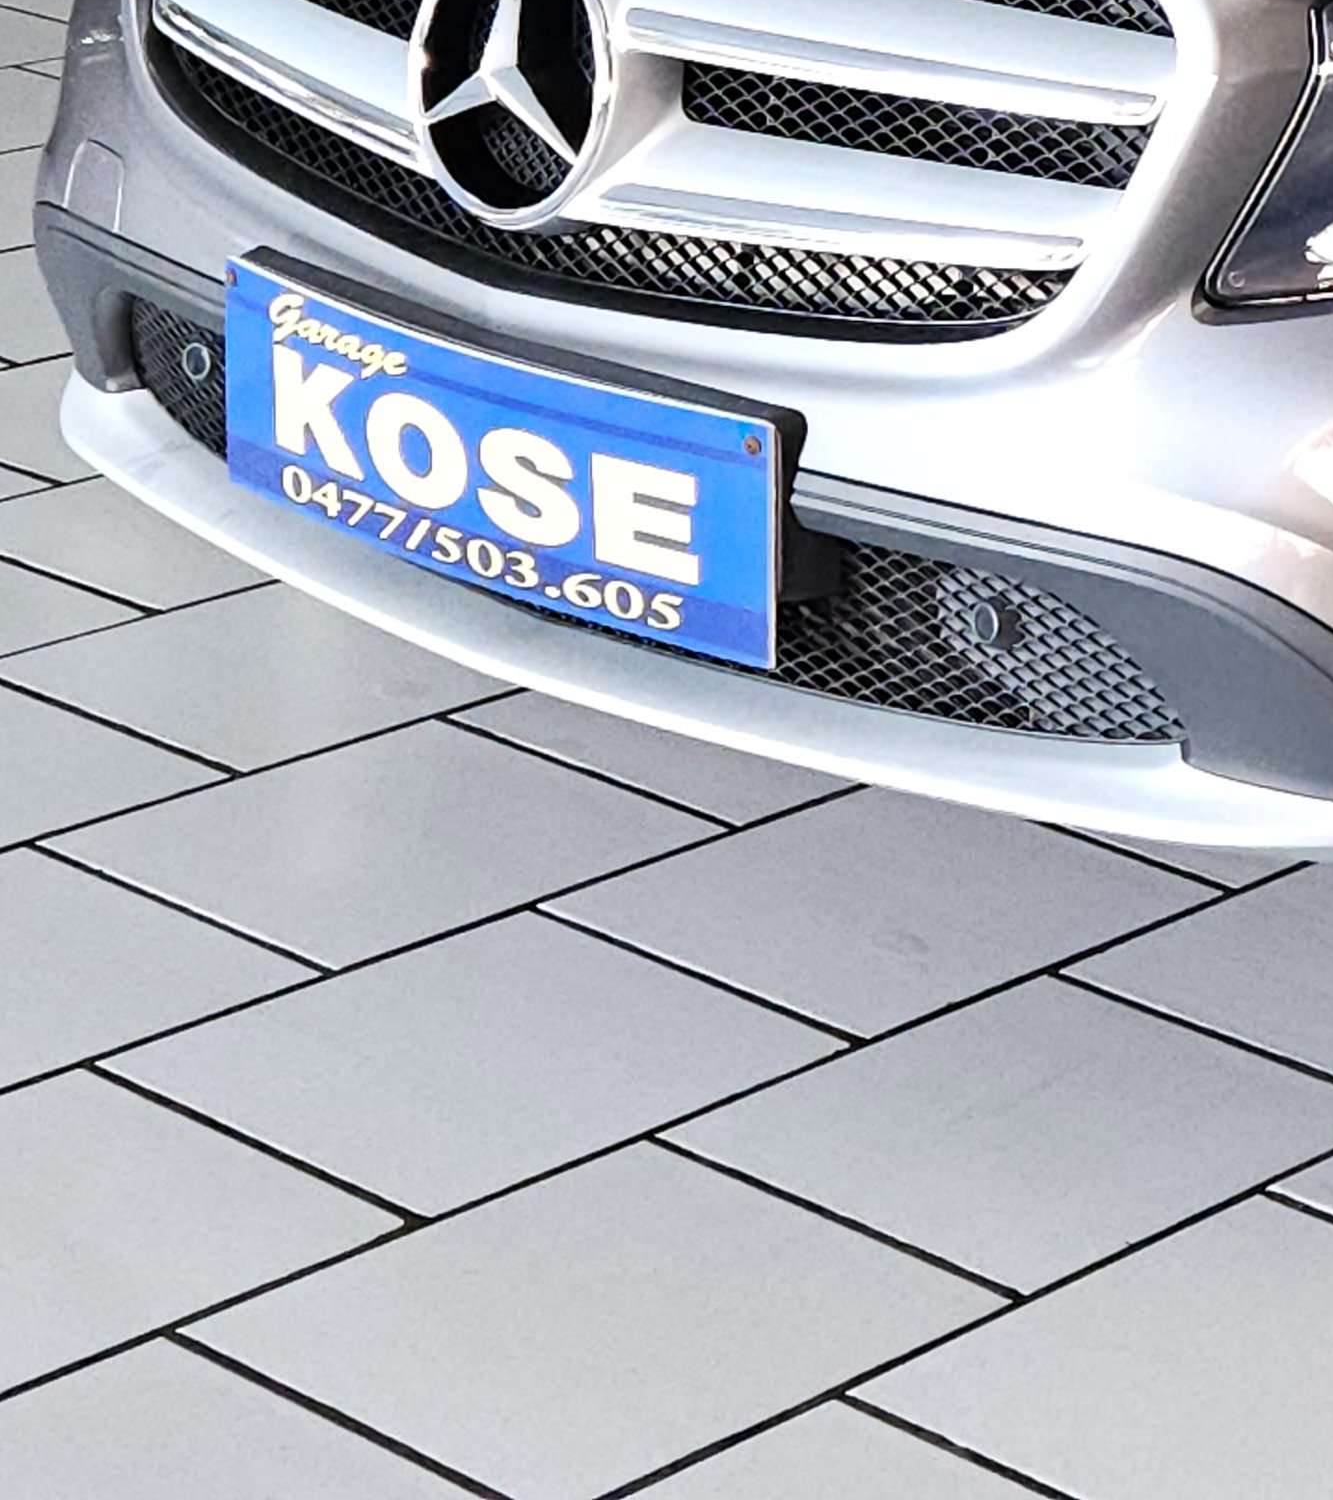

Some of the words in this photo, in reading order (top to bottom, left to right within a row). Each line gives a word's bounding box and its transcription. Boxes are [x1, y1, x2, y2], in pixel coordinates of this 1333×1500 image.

[267, 293, 408, 378] Garage
[272, 343, 700, 586] KOSE
[281, 464, 685, 631] 0477/503.605
